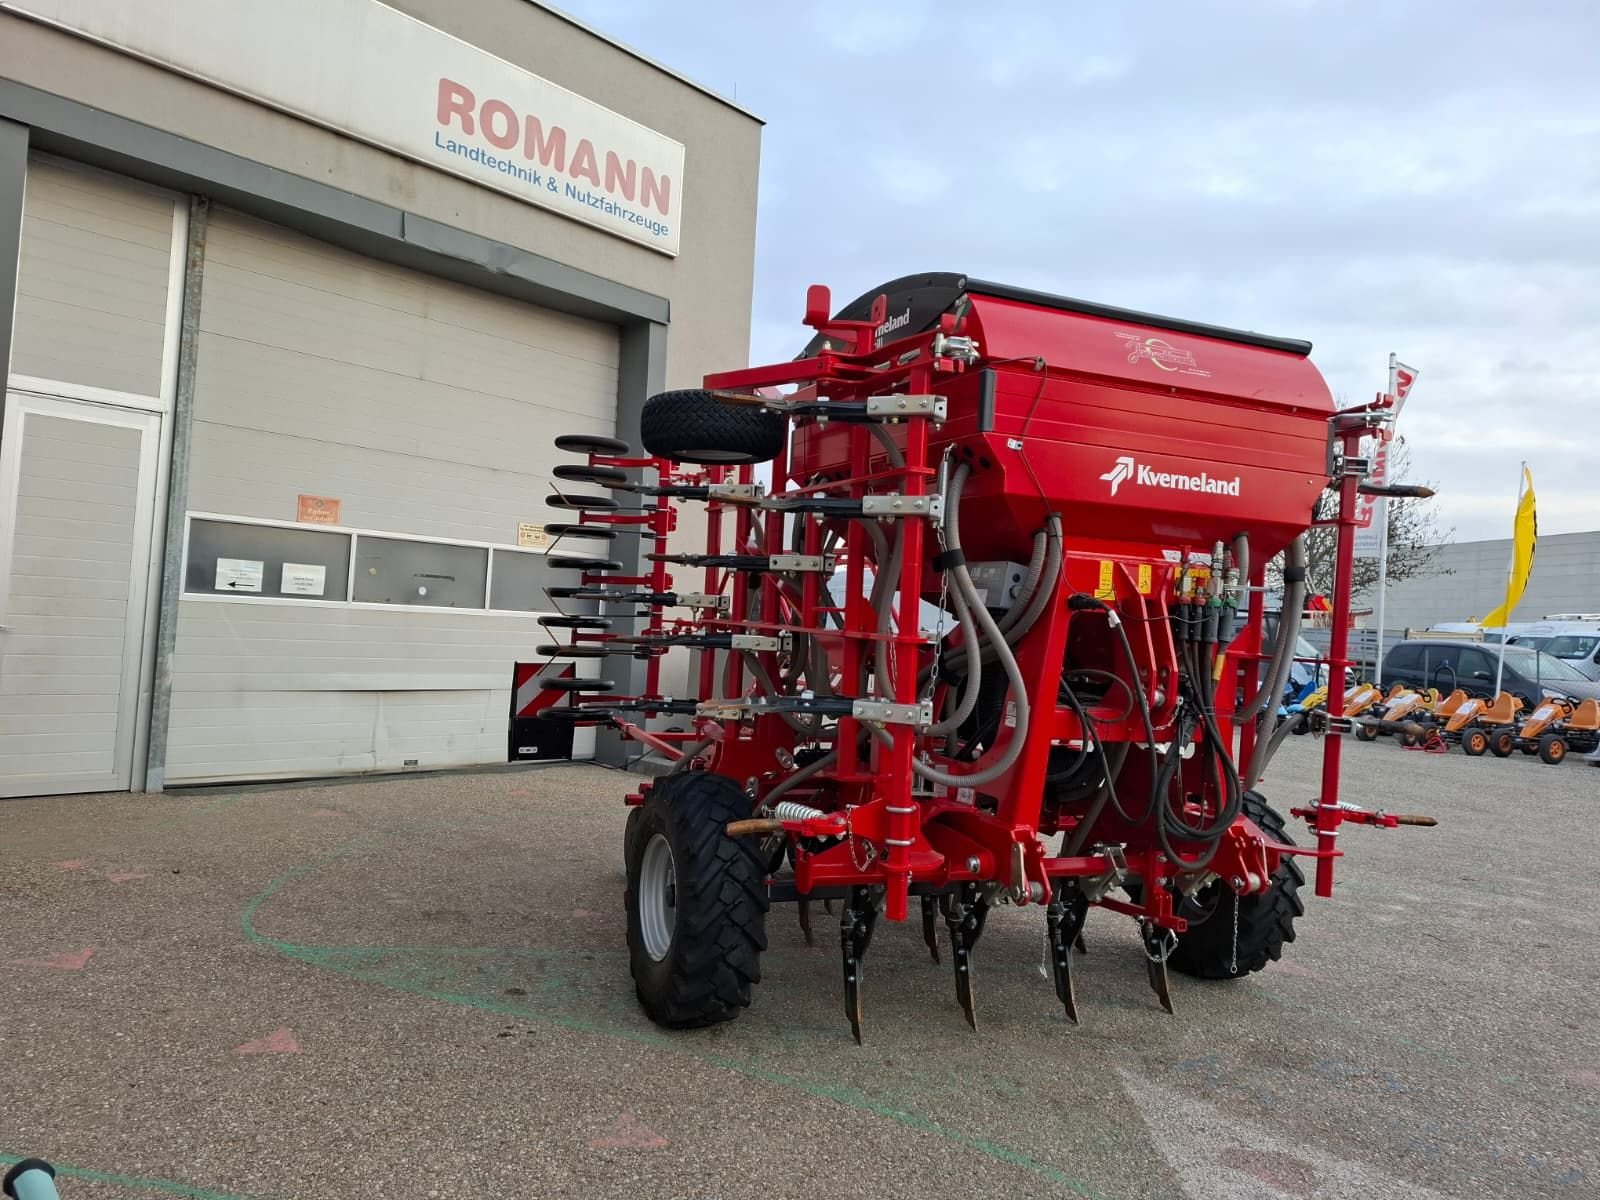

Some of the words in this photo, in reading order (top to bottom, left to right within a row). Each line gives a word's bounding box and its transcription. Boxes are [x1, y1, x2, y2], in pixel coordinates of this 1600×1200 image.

[437, 78, 671, 216] ROMANN
[434, 131, 541, 187] Landtechnik
[546, 176, 558, 193] &
[565, 182, 669, 236] Nutzfahrzeuge
[874, 307, 910, 338] rneland
[1137, 464, 1240, 496] Kverneland
